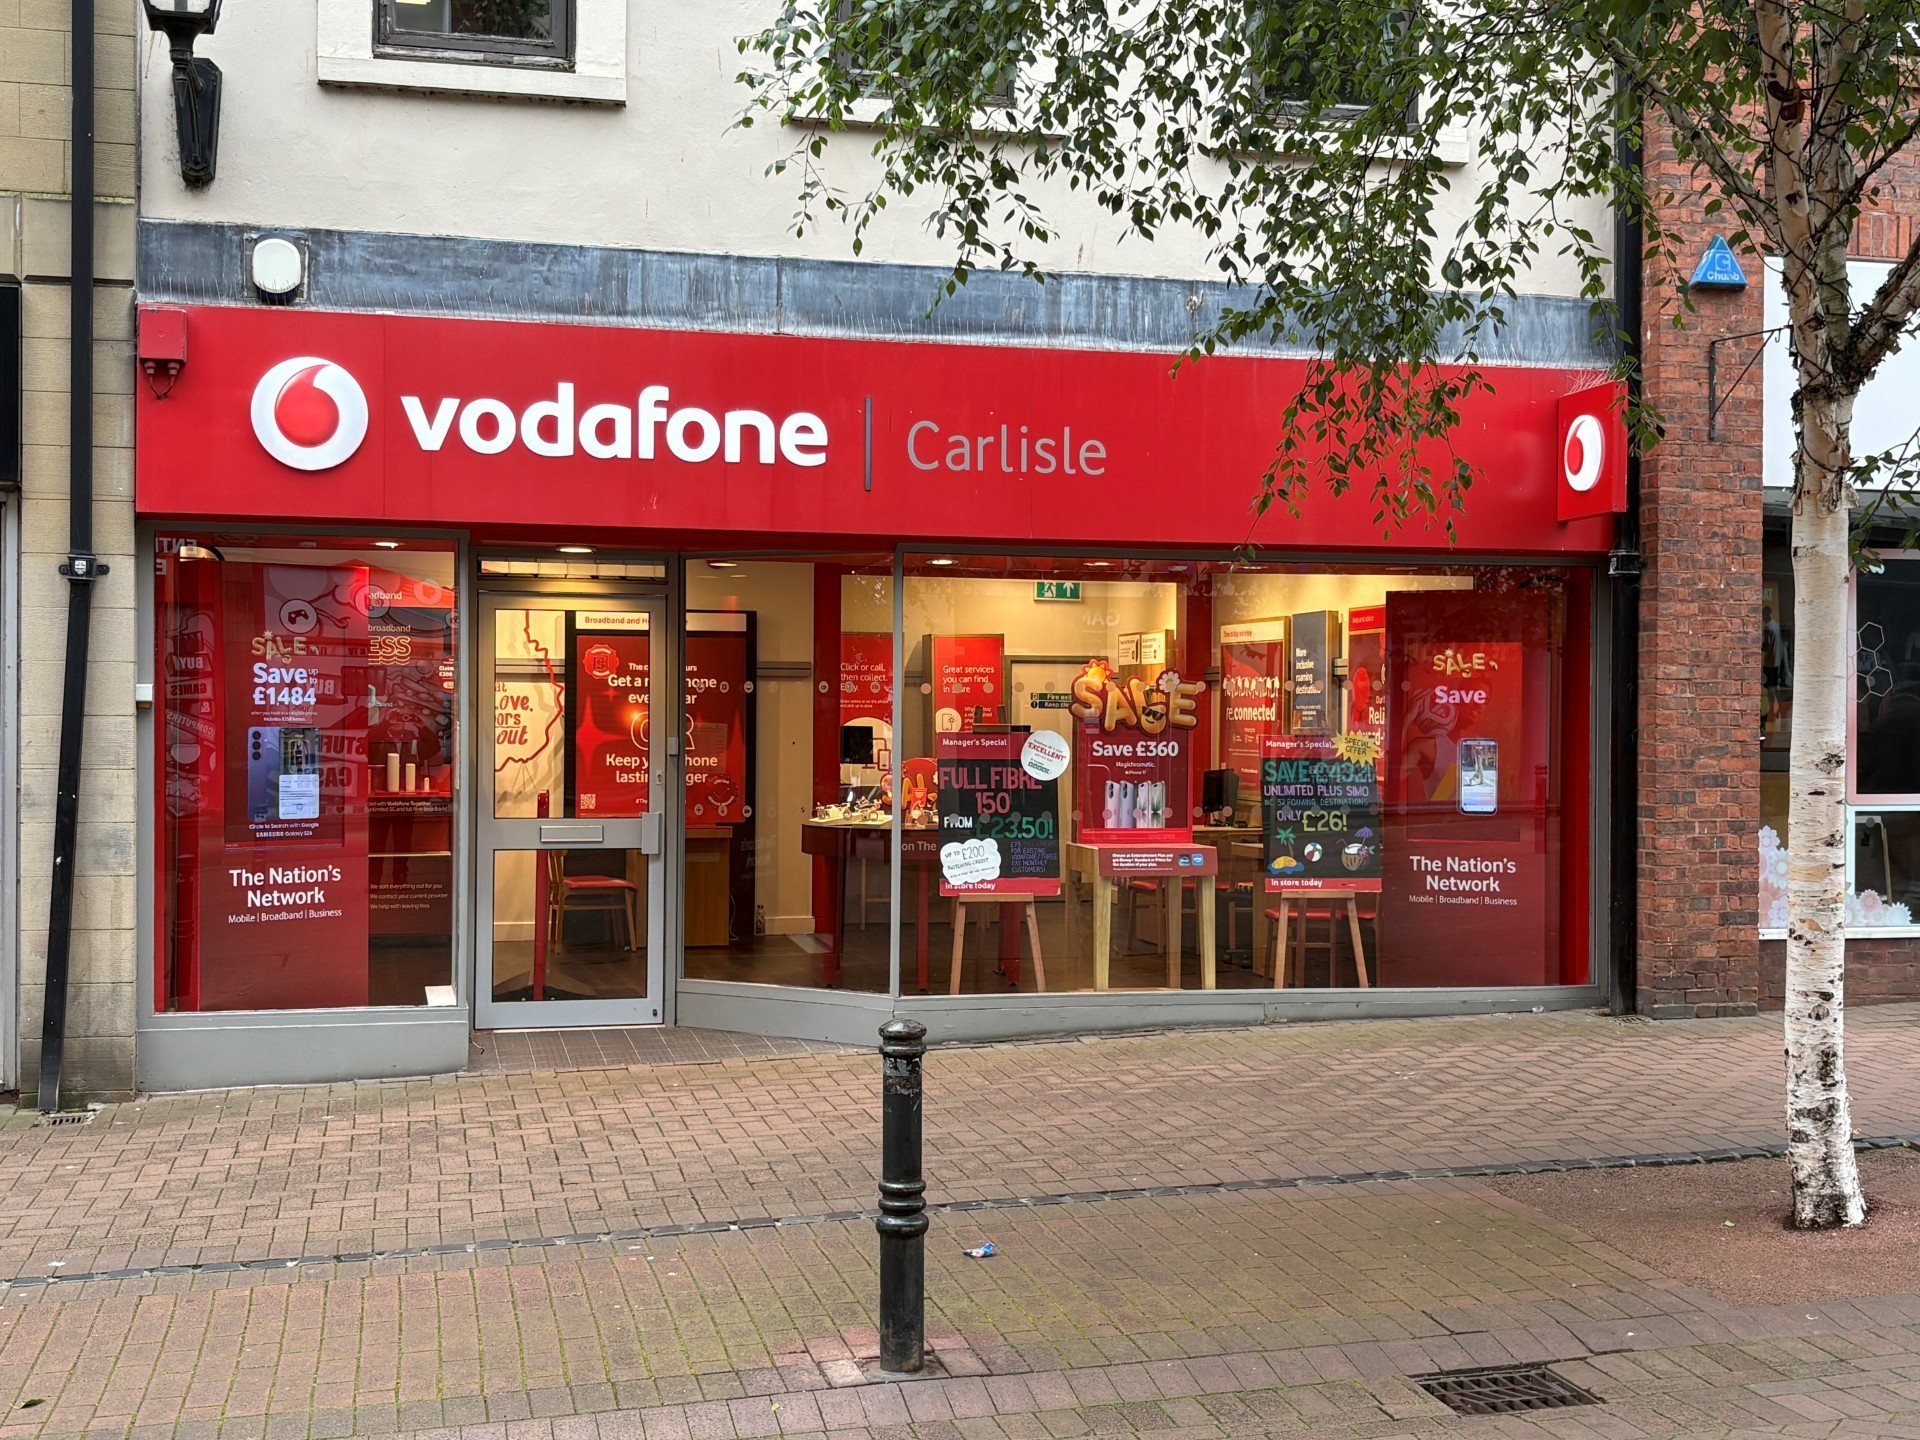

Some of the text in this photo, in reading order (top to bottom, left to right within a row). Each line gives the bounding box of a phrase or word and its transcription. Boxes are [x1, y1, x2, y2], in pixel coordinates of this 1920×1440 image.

[400, 382, 1107, 475] vodafone Carlisle
[584, 616, 640, 624] Broadband and
[252, 636, 307, 661] SALE
[1296, 648, 1307, 657] More
[628, 662, 642, 671] The
[840, 662, 859, 671] Click
[942, 666, 994, 674] Great services
[1296, 660, 1314, 670] inclusive
[1432, 653, 1486, 676] SALE
[253, 662, 318, 684] Save up to
[840, 673, 888, 682] then collect.
[942, 676, 957, 684] you
[608, 674, 641, 687] Get a
[840, 683, 860, 693] Ey.
[1434, 686, 1486, 704] Save
[1071, 677, 1203, 732] SALE
[496, 726, 528, 746] out
[942, 739, 980, 747] Manager's
[1344, 737, 1371, 748] SPECIAL
[1092, 740, 1179, 757] Save £360
[1266, 740, 1332, 750] Manager's Special
[1345, 745, 1367, 756] OFFER
[606, 754, 640, 769] Keep
[940, 767, 988, 789] FULL
[1264, 760, 1309, 782] SAVE
[1264, 785, 1369, 796] UNLIMITED PLUS SIMO
[975, 792, 1011, 814] 150
[1277, 798, 1286, 806] 52
[1320, 798, 1368, 806] DESTINATIONS
[975, 816, 1054, 840] £23.50!
[1277, 810, 1348, 832] ONLY £26!
[917, 841, 937, 850] The
[962, 845, 985, 860] £200
[1409, 856, 1516, 874] The Nation's
[229, 865, 341, 887] The Nation's
[975, 882, 996, 890] today
[1302, 879, 1323, 888] today
[1426, 875, 1500, 892] Network
[247, 886, 325, 908] Network
[1409, 895, 1517, 906] Mobile Broadband Business
[228, 908, 342, 924] Mobile Broadband Business
